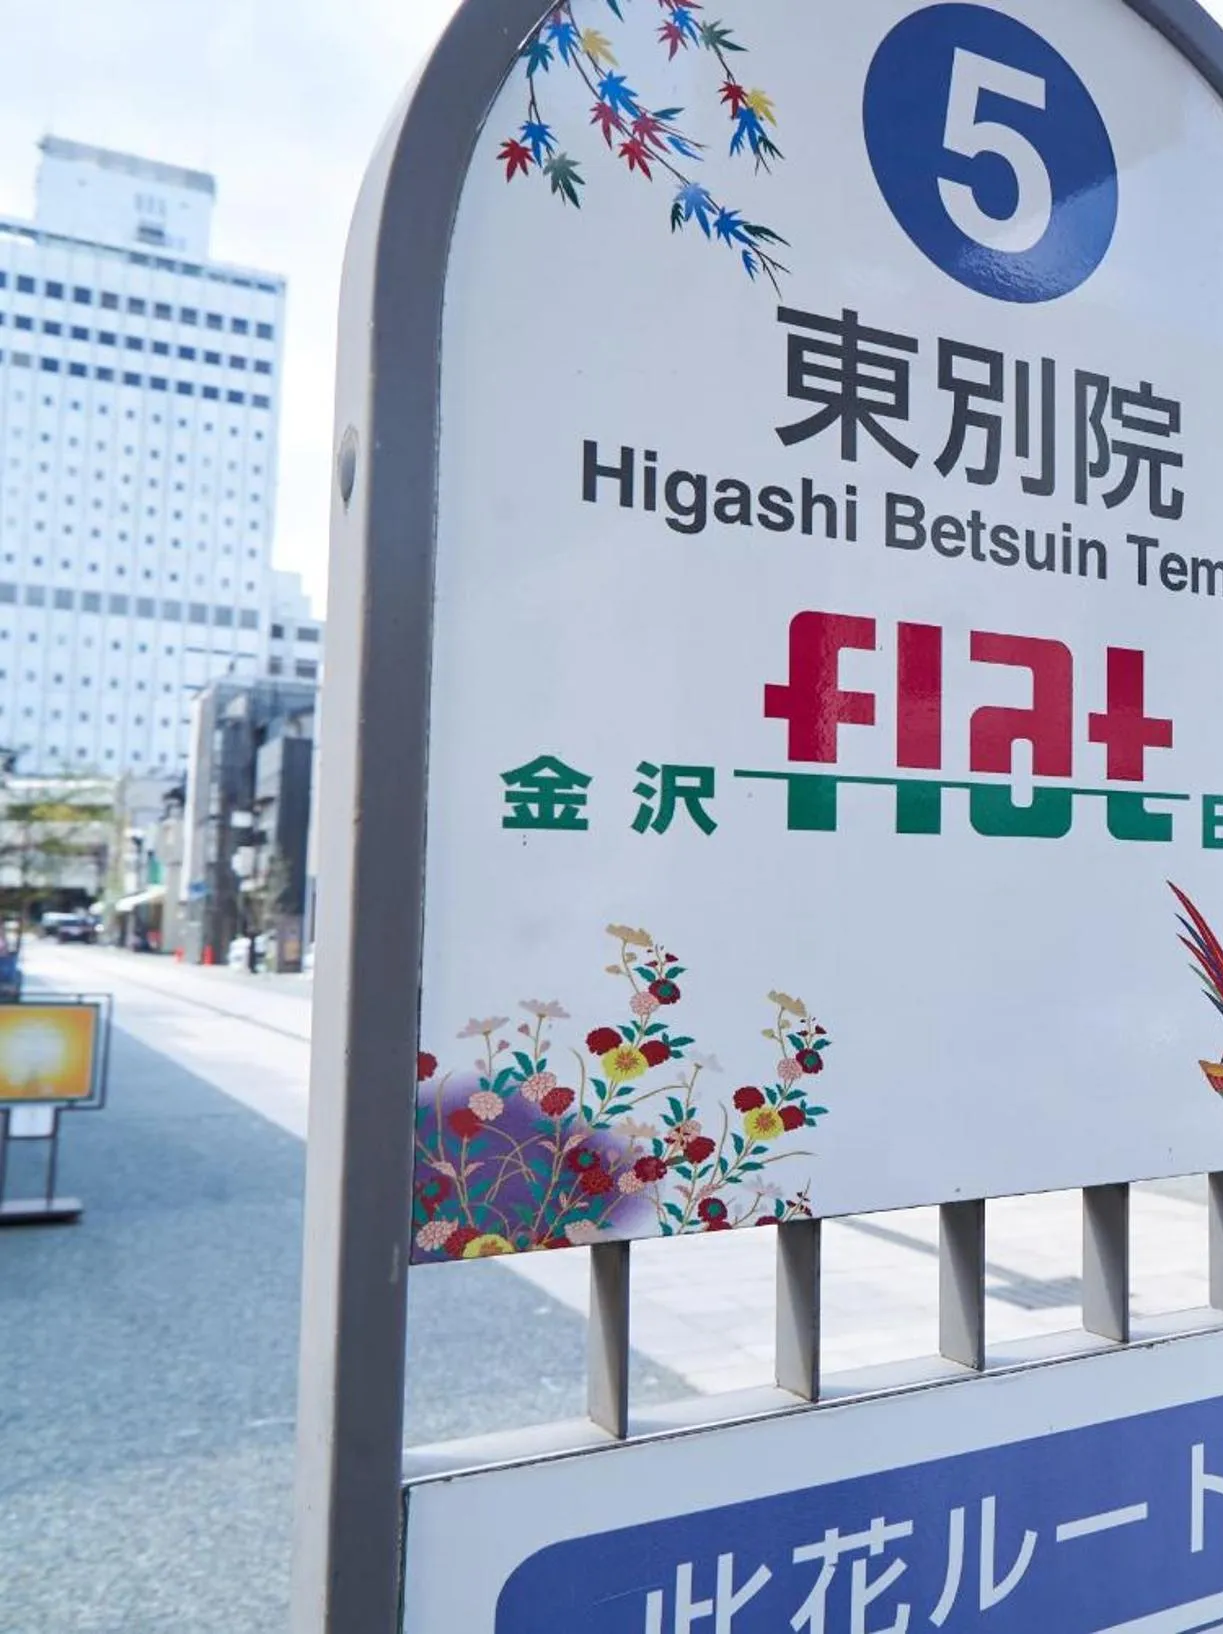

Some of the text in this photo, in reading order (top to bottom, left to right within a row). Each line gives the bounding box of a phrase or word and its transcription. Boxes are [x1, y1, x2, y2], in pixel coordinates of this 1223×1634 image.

[937, 47, 1053, 253] 5
[582, 439, 858, 543] Higashi
[885, 492, 1107, 581] Betsuin
[775, 305, 1185, 520] 東別院
[763, 611, 1175, 812] flat
